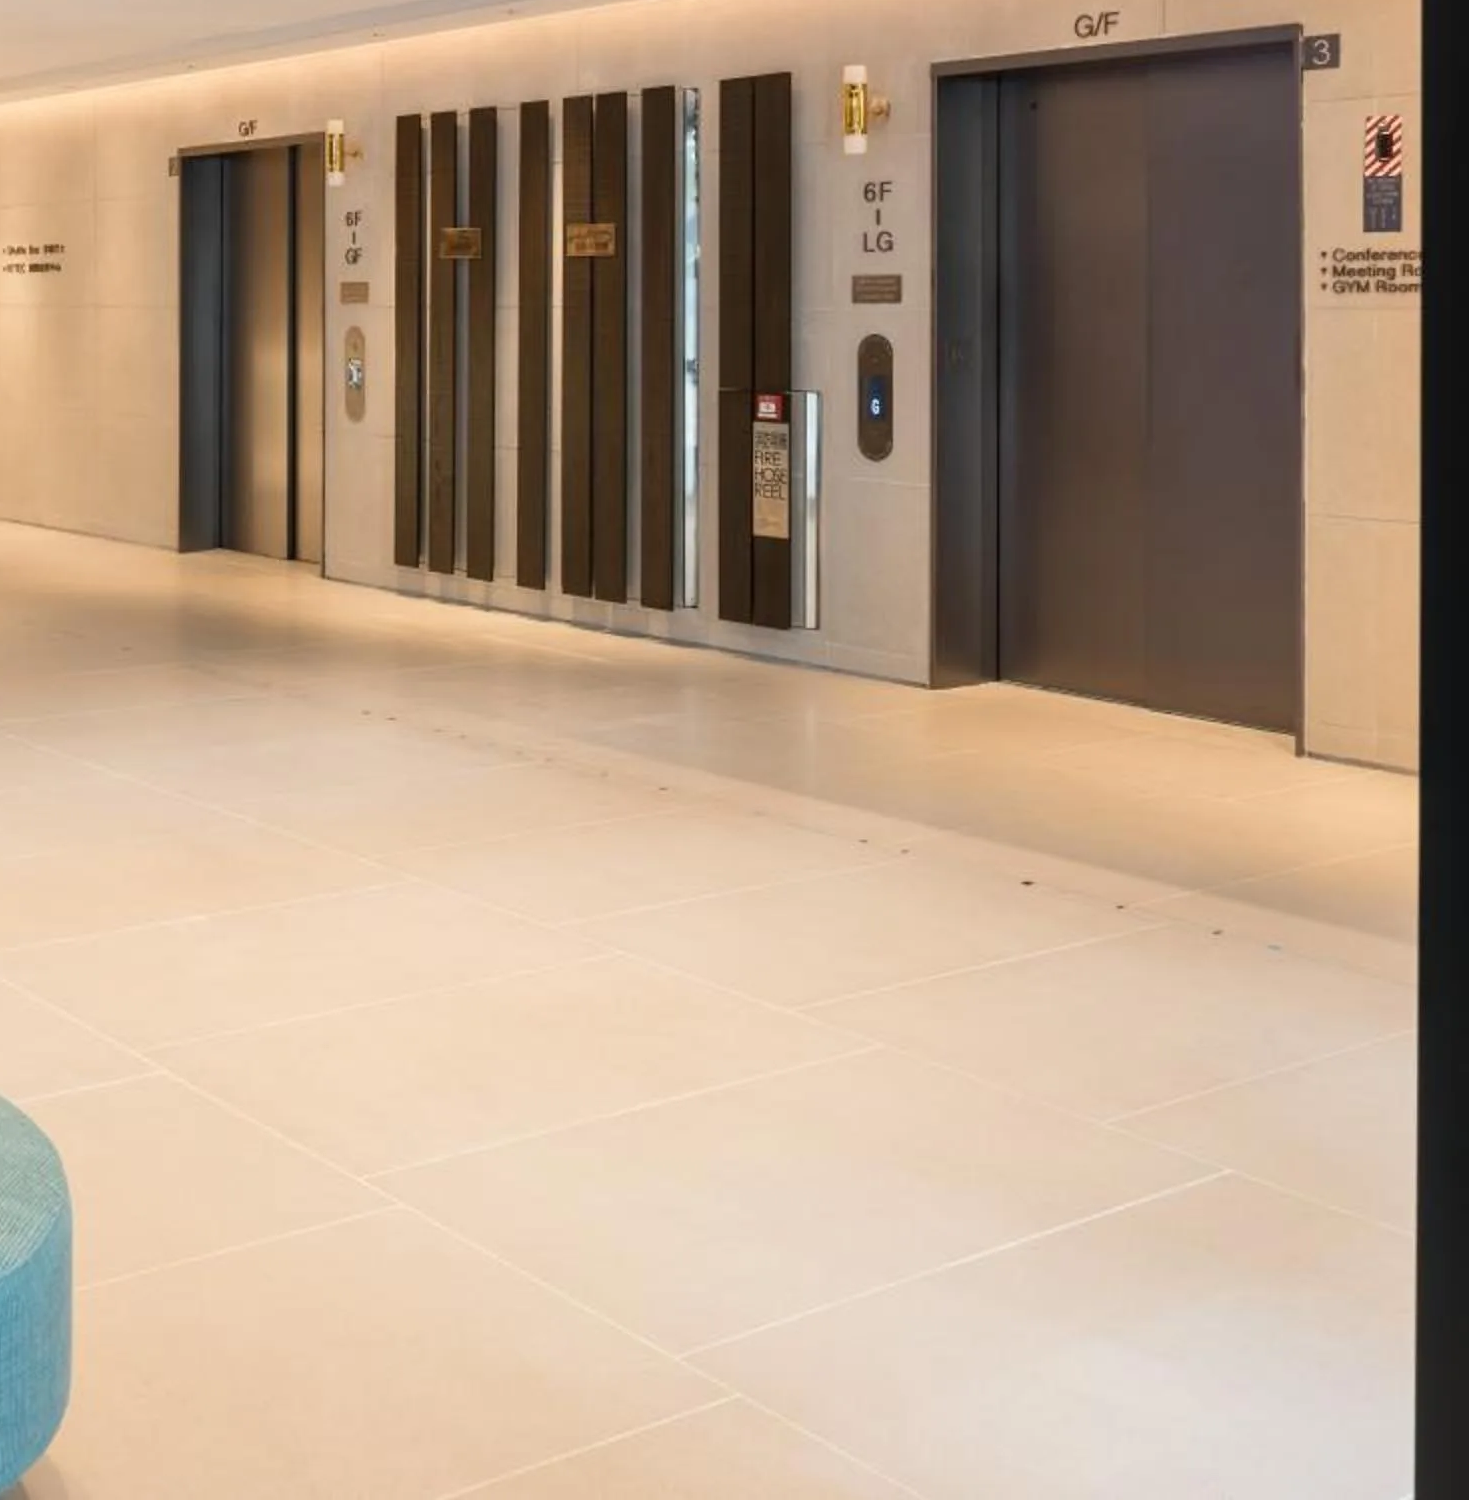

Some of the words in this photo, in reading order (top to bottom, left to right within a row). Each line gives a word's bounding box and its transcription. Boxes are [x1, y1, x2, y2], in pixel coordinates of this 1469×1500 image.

[1074, 11, 1120, 39] G/F
[1312, 39, 1331, 66] 3
[863, 181, 893, 203] 6F
[862, 231, 893, 253] LG
[1332, 264, 1396, 280] Meeting
[1332, 280, 1370, 294] GYM
[754, 450, 782, 467] FIRE
[754, 466, 788, 485] HOSE
[754, 482, 786, 500] REEL
